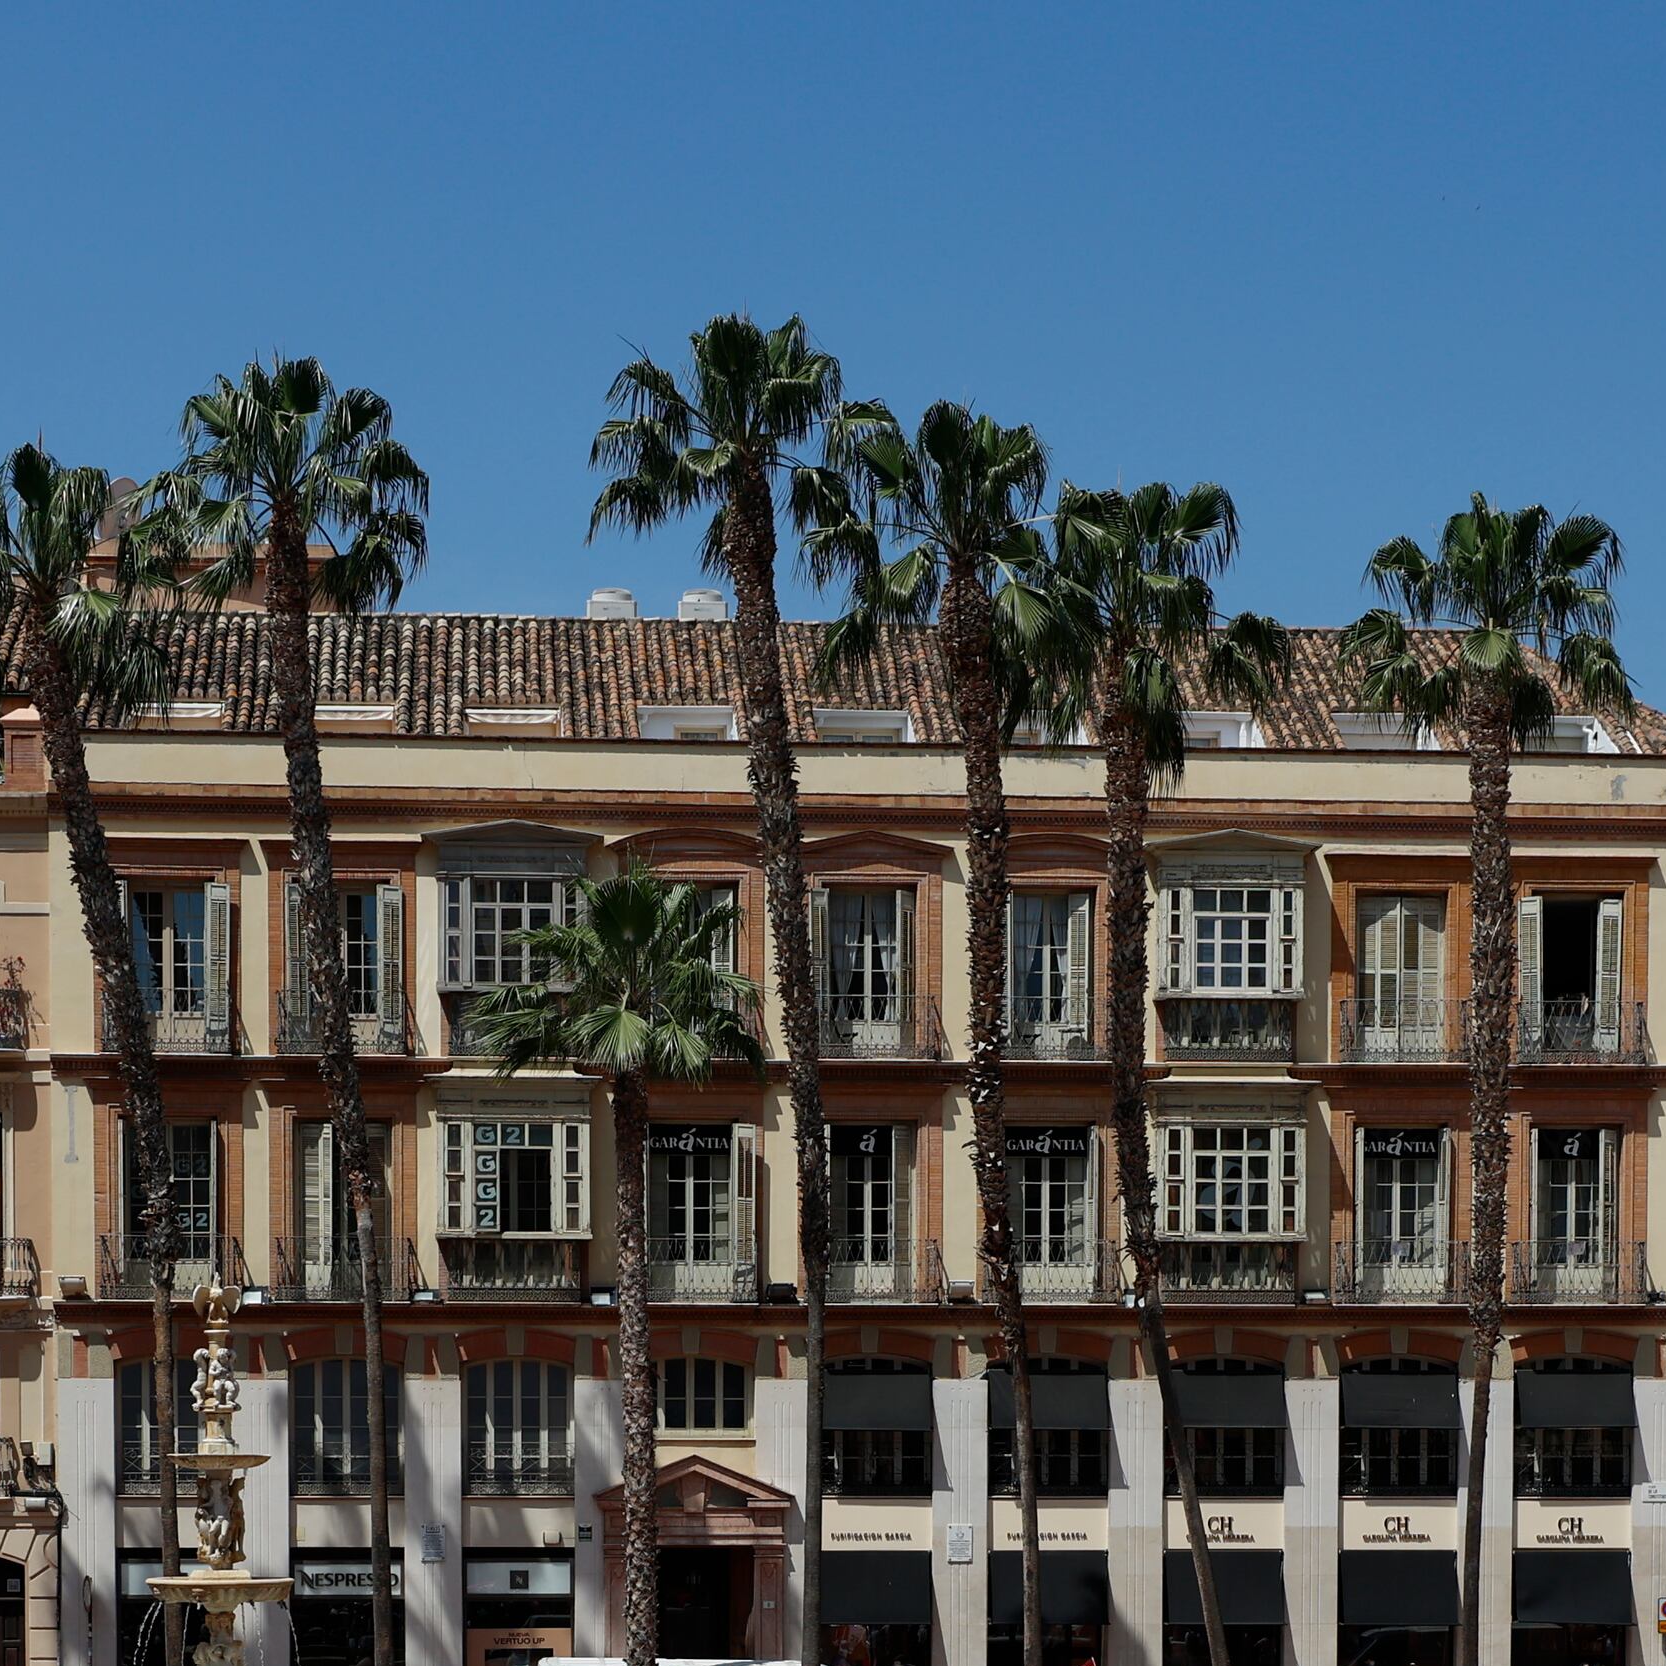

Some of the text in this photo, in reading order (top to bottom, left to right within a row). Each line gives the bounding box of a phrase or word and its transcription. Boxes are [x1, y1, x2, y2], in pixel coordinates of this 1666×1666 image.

[1207, 1516, 1235, 1535] CH
[1384, 1516, 1411, 1534] CH
[1557, 1516, 1584, 1534] CH
[831, 1532, 883, 1542] PURIFICACION
[1398, 1533, 1431, 1544] HERRERA
[1571, 1534, 1605, 1545] HERRERA
[300, 1571, 399, 1592] NESPRESO
[495, 1637, 545, 1645] VERTUO UP
